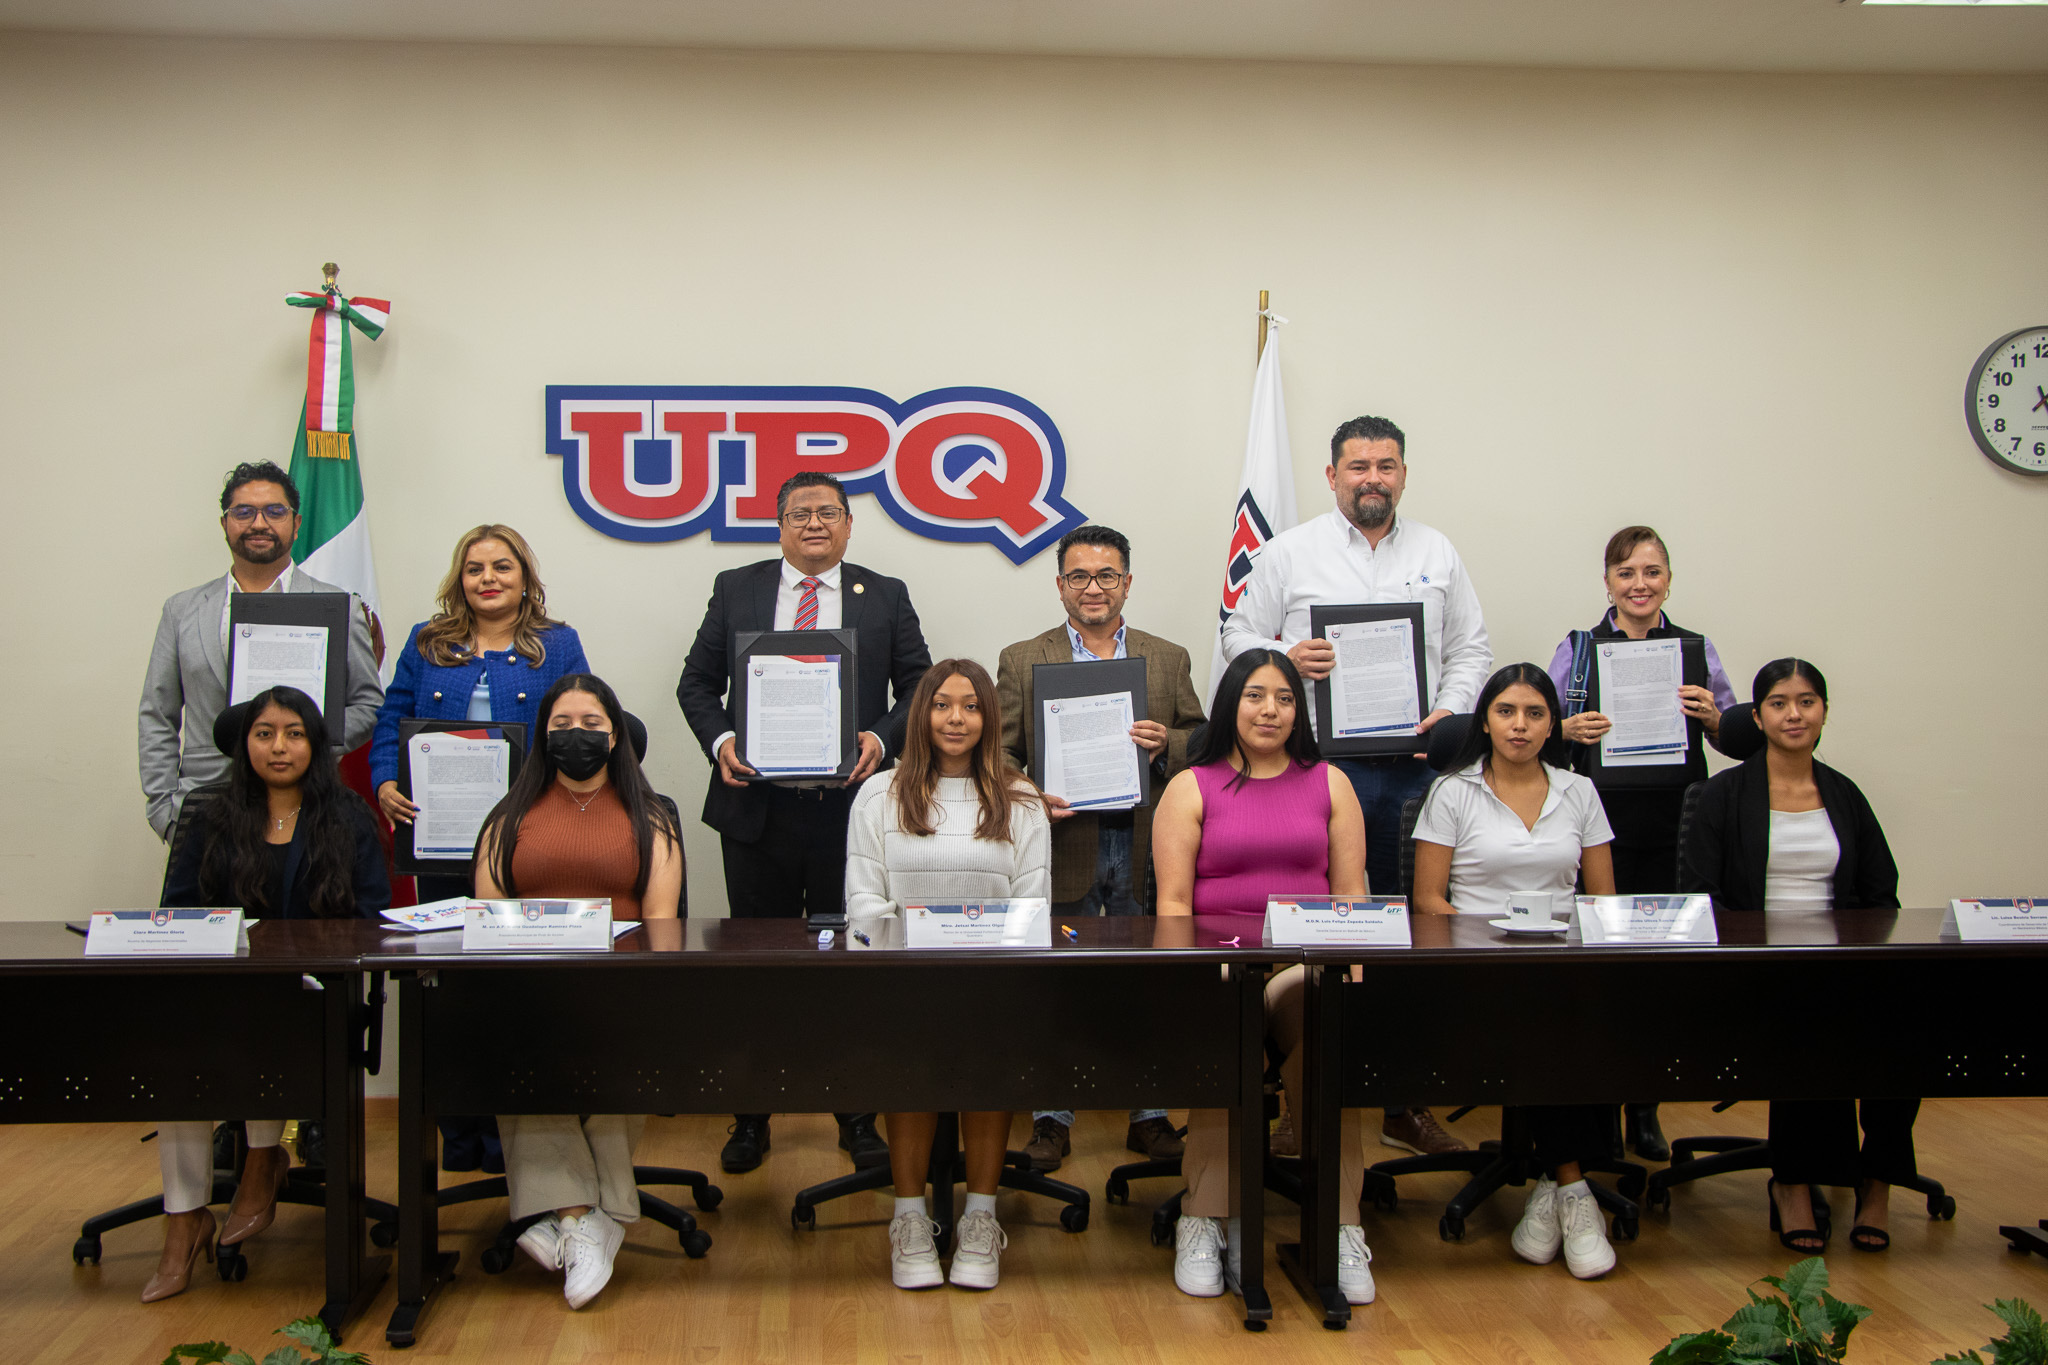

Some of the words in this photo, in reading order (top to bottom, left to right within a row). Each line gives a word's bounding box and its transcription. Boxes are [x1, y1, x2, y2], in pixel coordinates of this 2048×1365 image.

[2011, 353, 2026, 368] 11
[1993, 371, 2013, 386] 10
[1988, 394, 2000, 408] 9
[1993, 418, 2006, 432] 8
[2010, 437, 2022, 451] 7
[2033, 442, 2046, 456] 6
[559, 398, 1068, 551] UPQ
